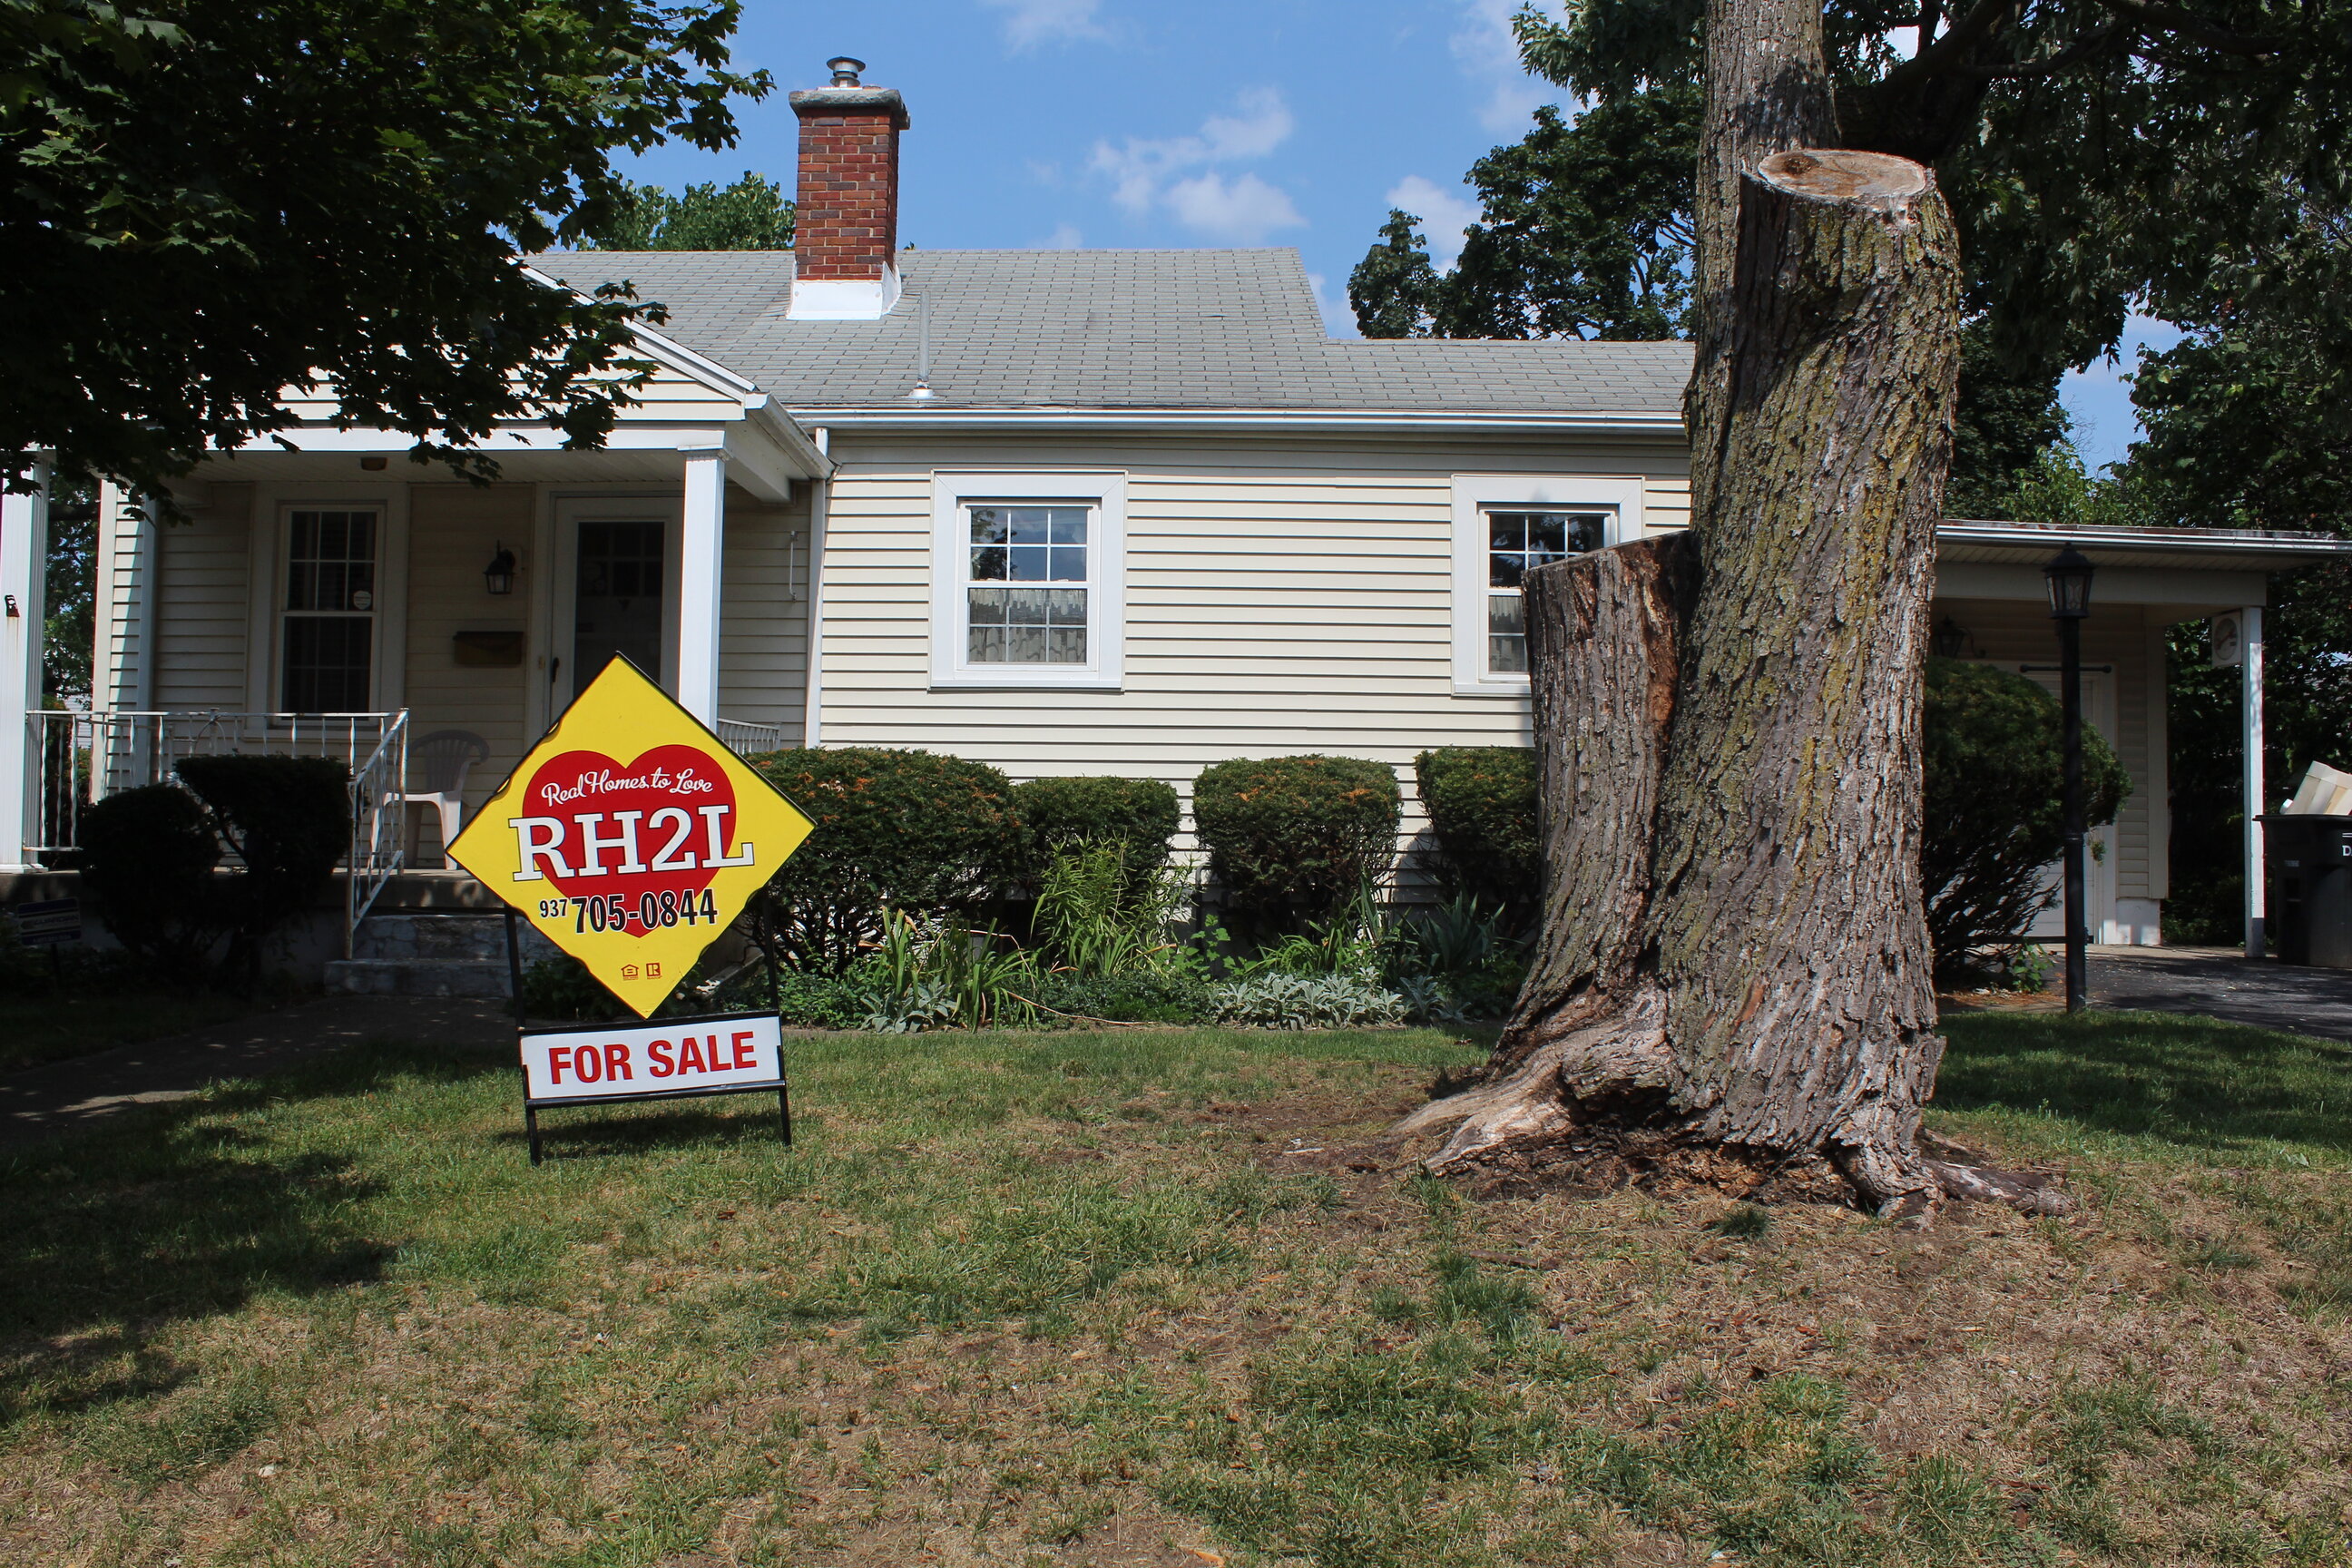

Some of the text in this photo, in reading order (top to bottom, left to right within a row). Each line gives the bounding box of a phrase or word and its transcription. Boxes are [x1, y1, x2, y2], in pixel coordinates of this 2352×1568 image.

[541, 767, 713, 807] Real Homes to Love
[508, 804, 755, 882] RH2L
[539, 887, 718, 934] 937 705-0844
[548, 1031, 757, 1084] FOR SALE
